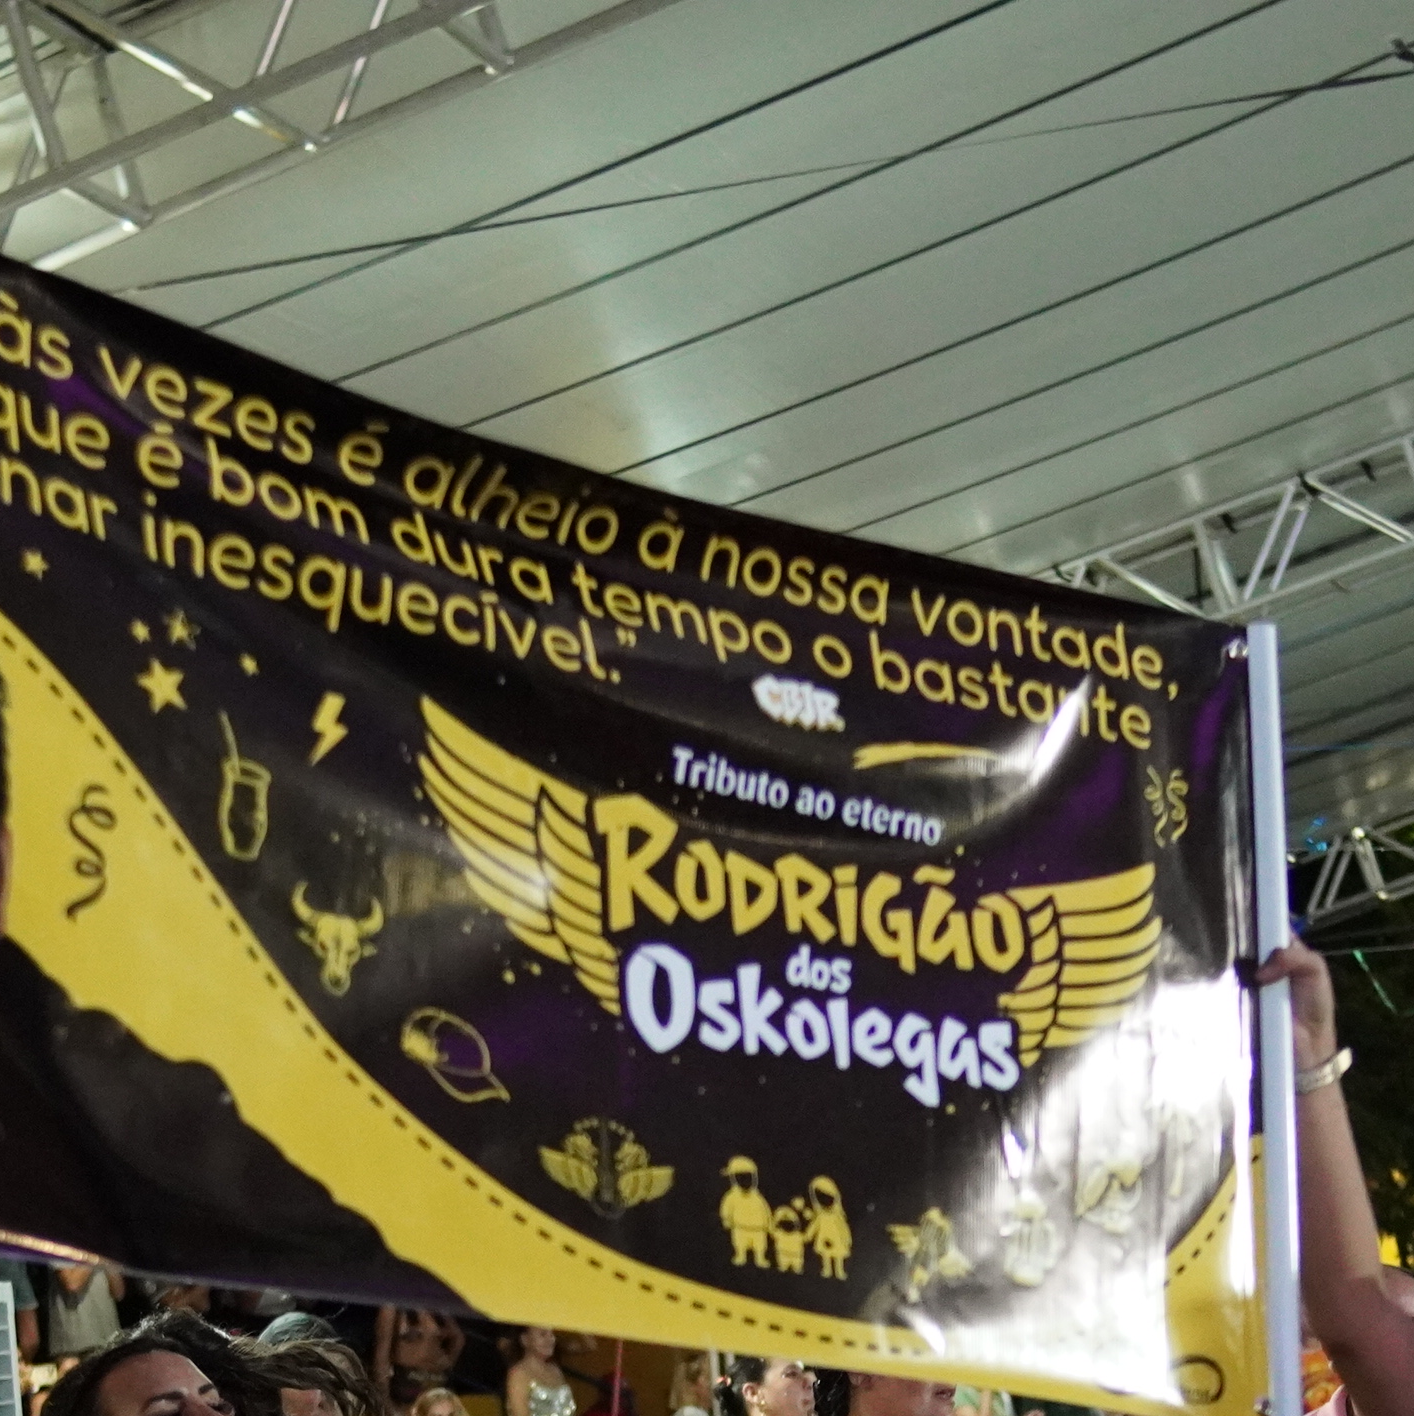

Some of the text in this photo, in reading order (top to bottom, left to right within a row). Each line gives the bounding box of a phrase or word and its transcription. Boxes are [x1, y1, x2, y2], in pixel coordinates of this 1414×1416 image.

[98, 346, 315, 465] vezes
[338, 424, 385, 486] é
[403, 452, 618, 556] alheio
[638, 506, 685, 573] à
[701, 537, 889, 625] nossa
[911, 588, 1179, 701] vontade,
[138, 423, 184, 487] é
[207, 438, 369, 545] bom
[391, 509, 553, 606] dura
[570, 561, 790, 664] tempo
[812, 633, 854, 679] o
[673, 746, 945, 848] Tributo ao eterno
[624, 942, 1020, 1110] Oskolegas
[785, 943, 853, 995] dos
